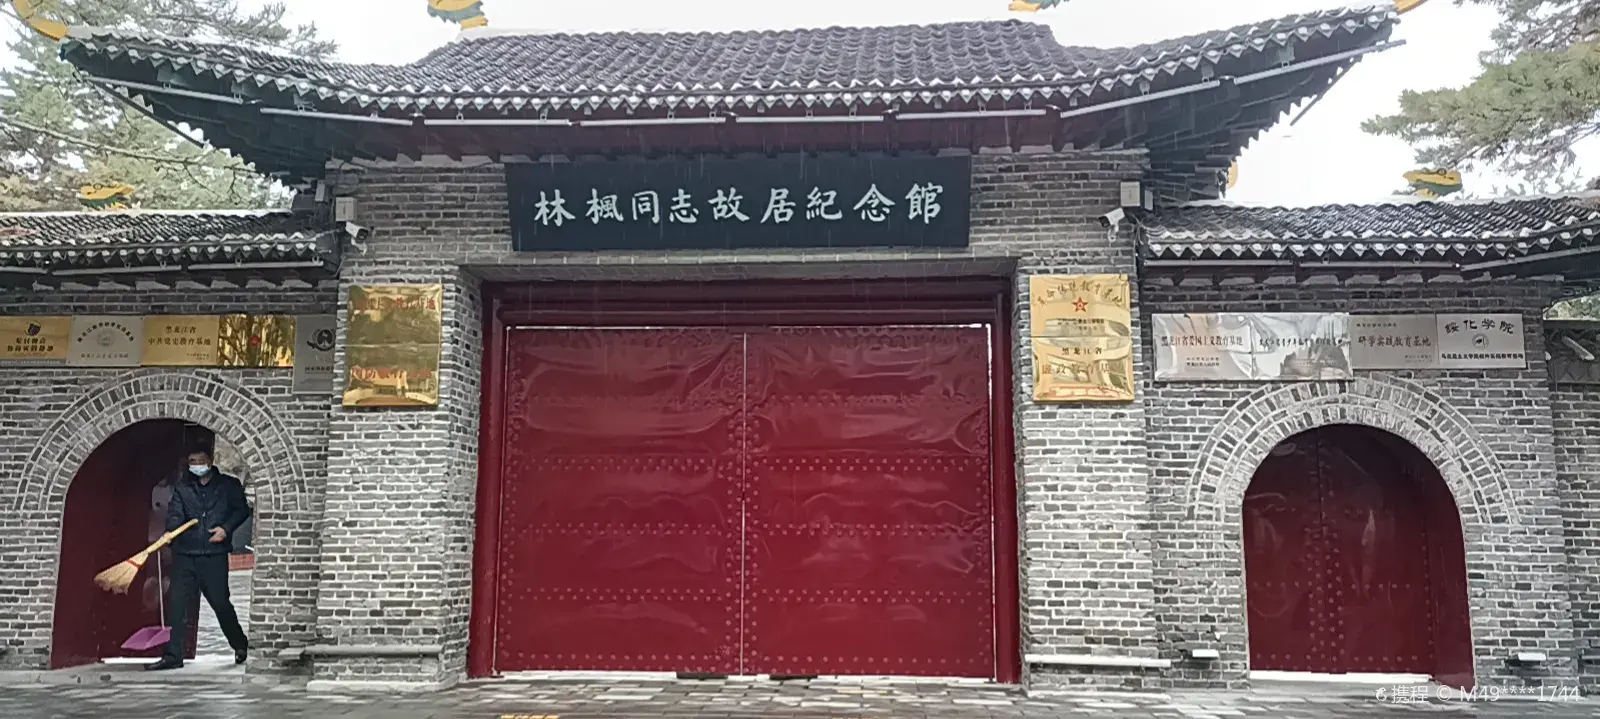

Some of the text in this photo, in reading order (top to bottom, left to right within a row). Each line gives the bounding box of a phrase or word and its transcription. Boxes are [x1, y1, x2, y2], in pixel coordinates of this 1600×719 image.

[533, 182, 945, 227] 林楓同志故居紀念館
[1444, 318, 1515, 334] 绥化学院
[1061, 346, 1102, 355] 黑龙江省
